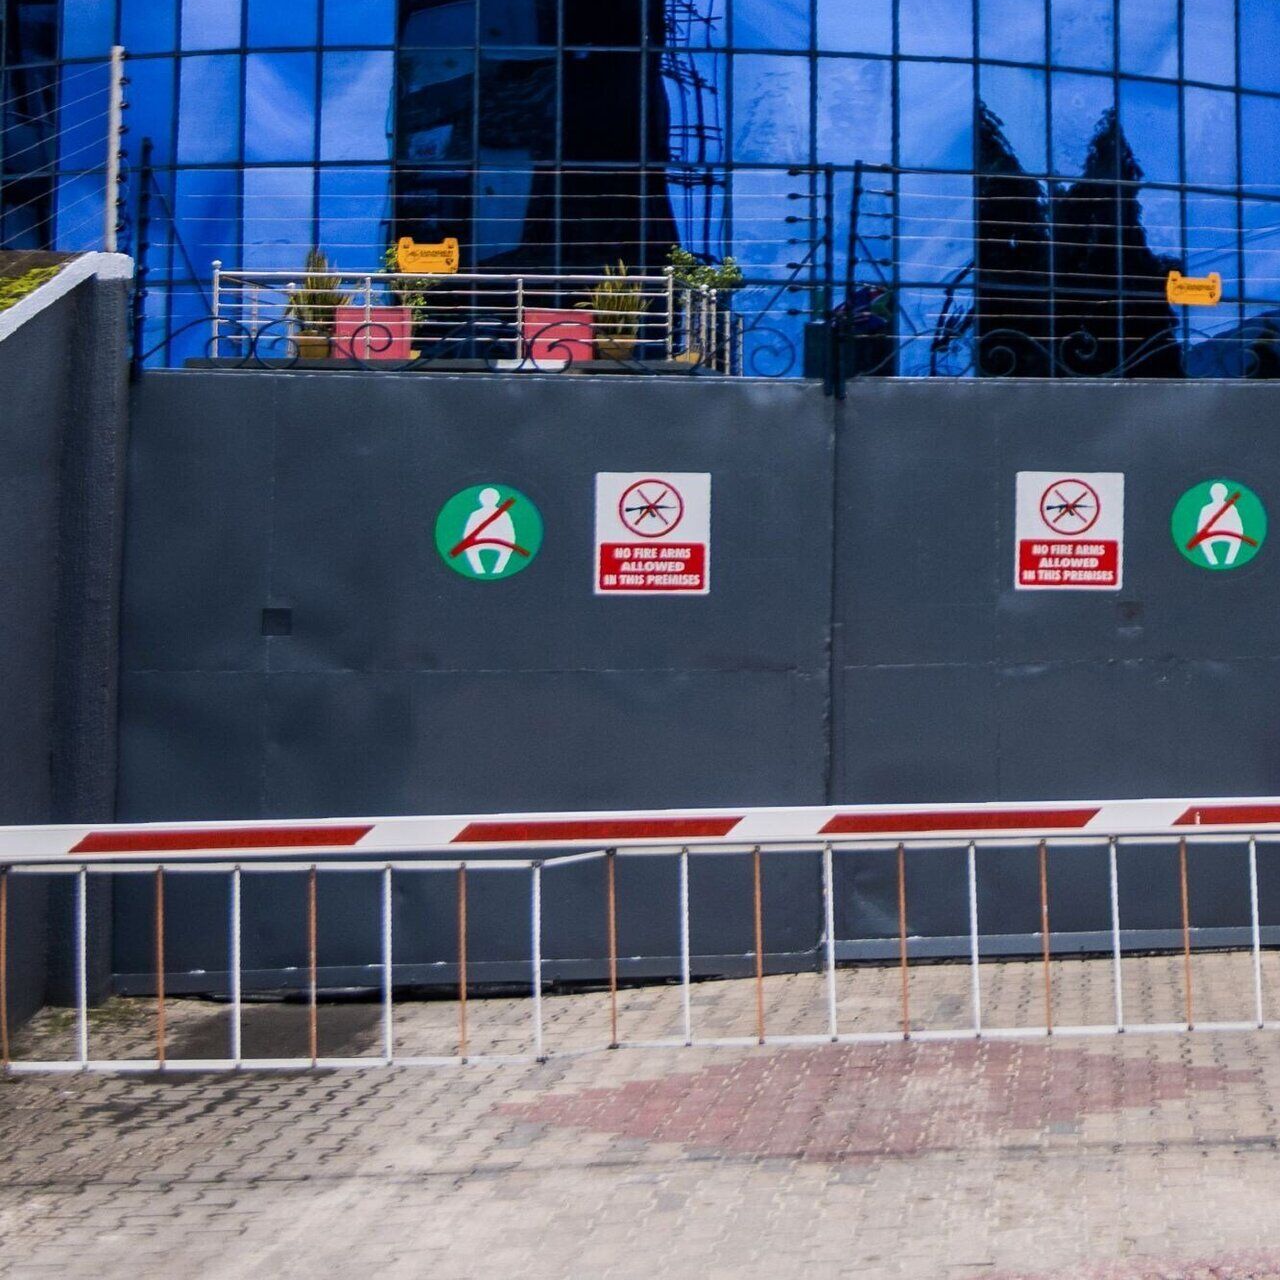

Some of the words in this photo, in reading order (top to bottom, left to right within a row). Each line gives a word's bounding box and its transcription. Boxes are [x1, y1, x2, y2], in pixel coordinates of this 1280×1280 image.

[614, 547, 631, 559] NO
[633, 547, 658, 559] FIRE
[660, 547, 692, 559] ARMS
[1031, 544, 1049, 555] NO
[1050, 544, 1073, 555] FIRE
[1075, 544, 1106, 556] ARMS
[620, 561, 686, 572] ALLOWED
[1038, 557, 1099, 568] ALLOWED
[603, 574, 617, 585] IN
[618, 574, 645, 586] THIS
[646, 574, 700, 586] PREMISES
[1022, 570, 1036, 580] IN
[1037, 570, 1061, 581] THIS
[1062, 570, 1114, 582] PREMISES
